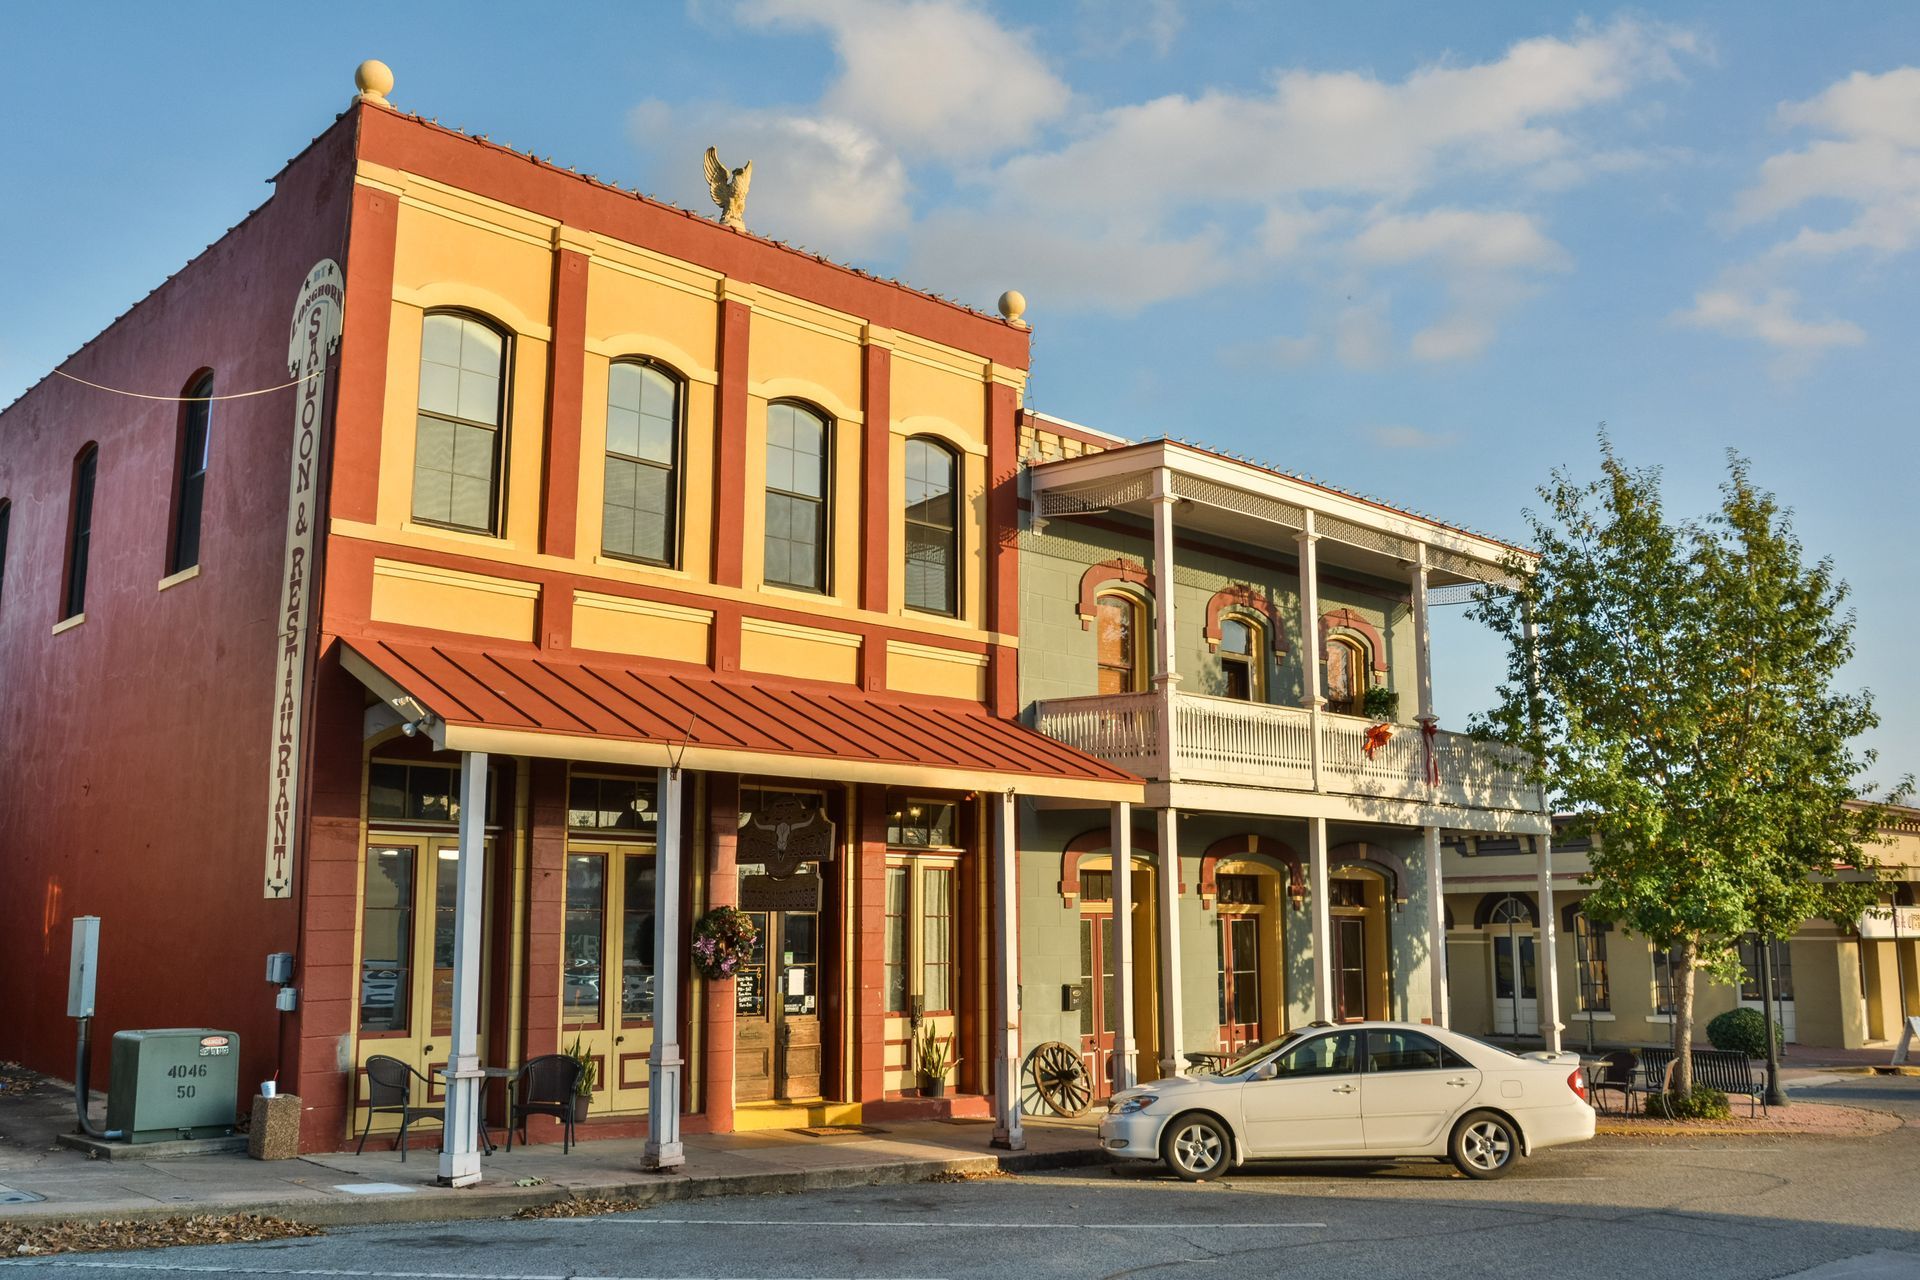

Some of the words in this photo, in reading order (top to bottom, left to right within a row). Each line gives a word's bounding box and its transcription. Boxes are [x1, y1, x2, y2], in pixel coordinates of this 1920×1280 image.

[290, 283, 344, 344] LONGHORN
[296, 306, 322, 494] SALOON
[295, 501, 309, 537] &
[272, 547, 304, 880] RESTAURANT
[167, 1064, 207, 1078] 4046
[177, 1085, 196, 1099] 50
